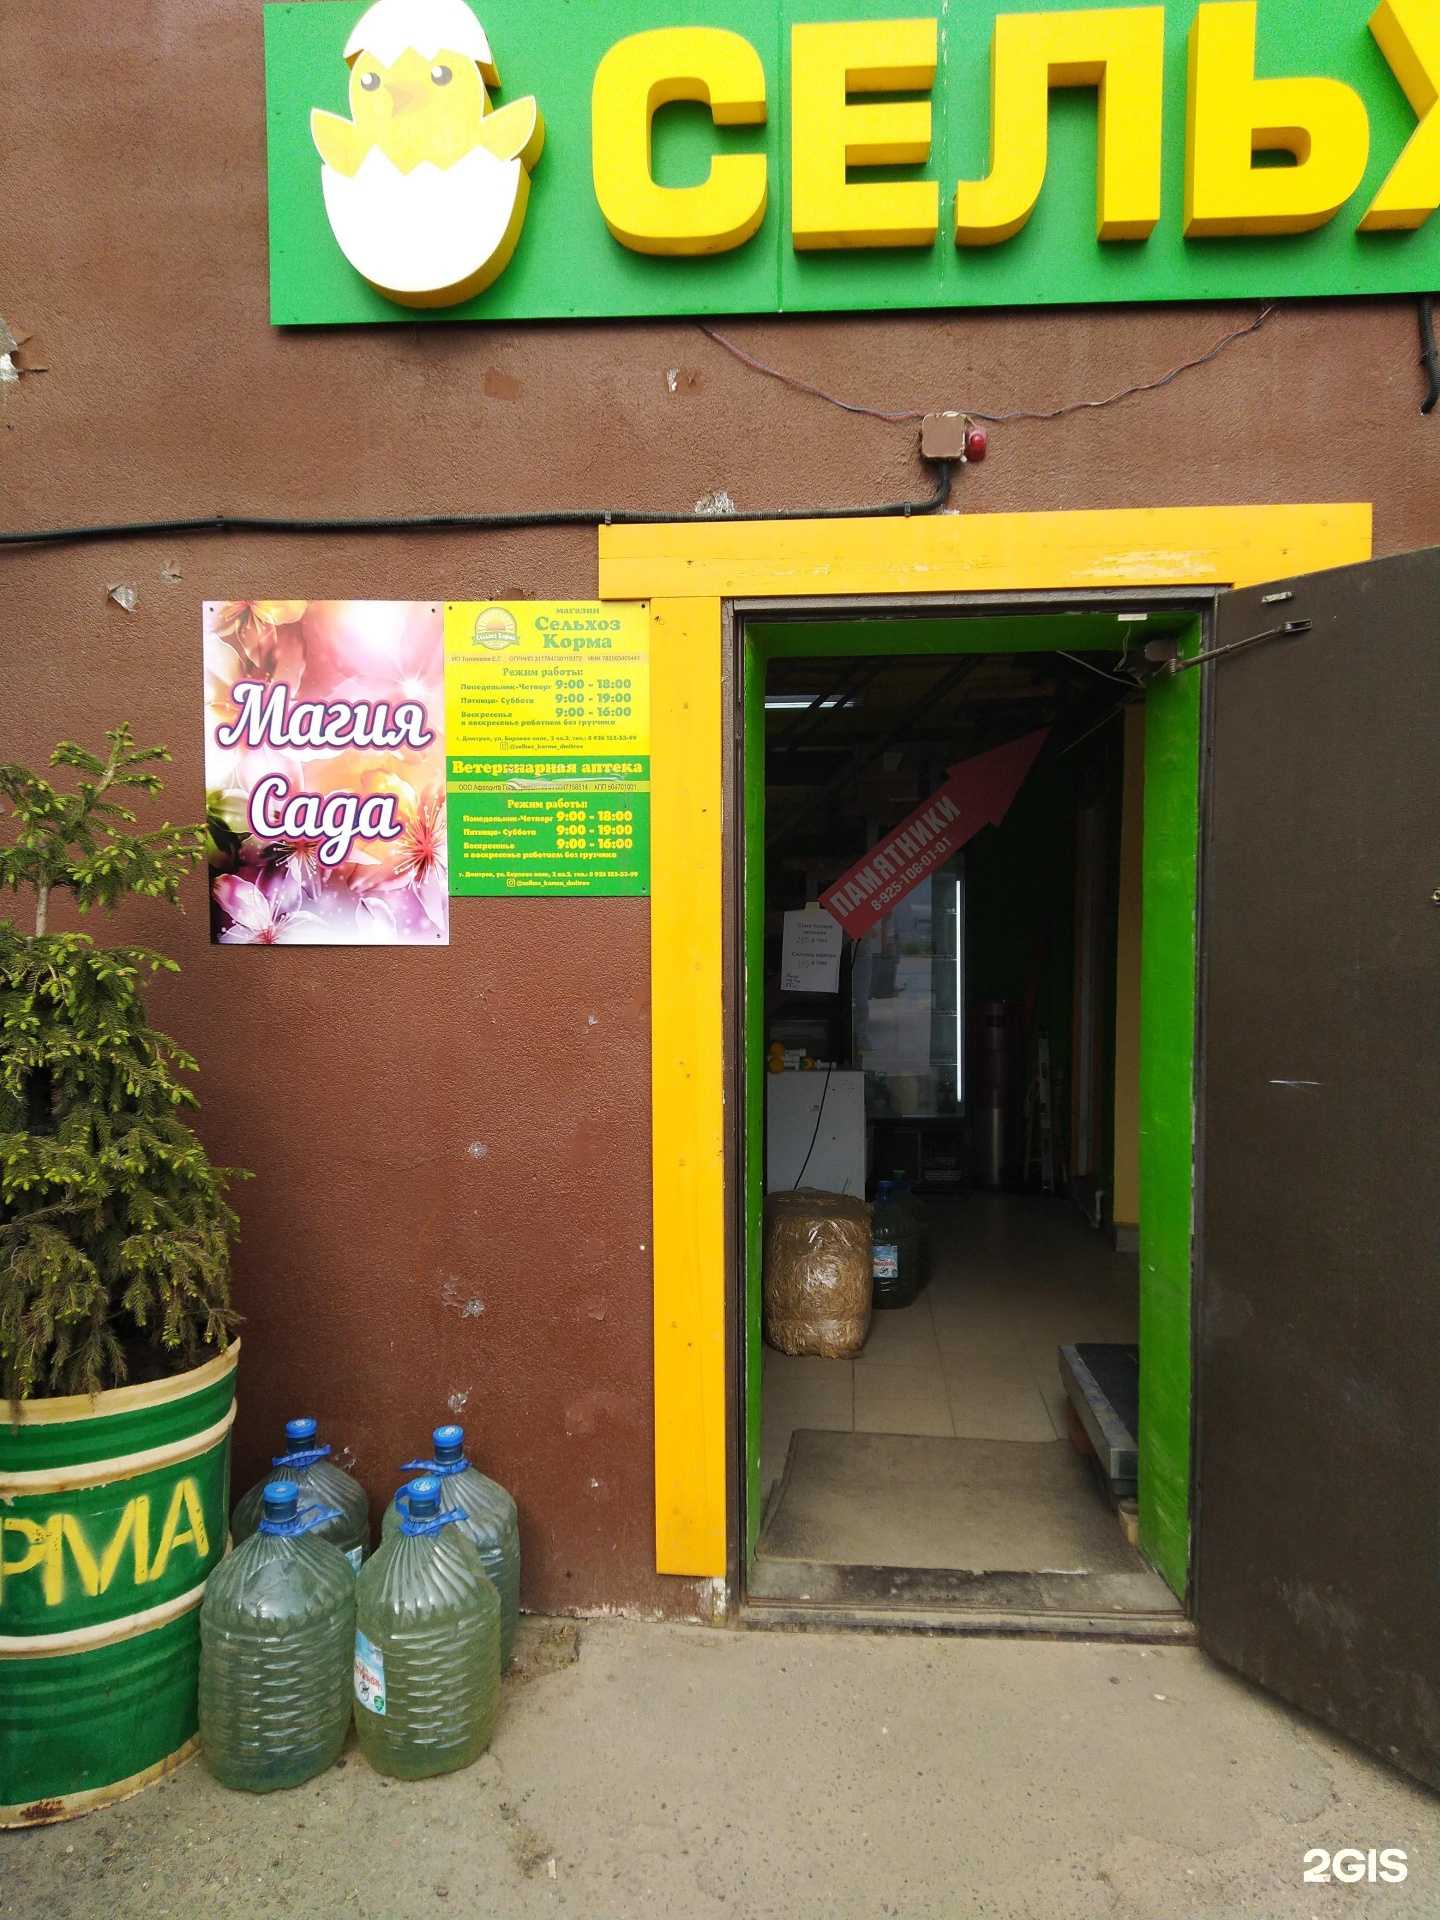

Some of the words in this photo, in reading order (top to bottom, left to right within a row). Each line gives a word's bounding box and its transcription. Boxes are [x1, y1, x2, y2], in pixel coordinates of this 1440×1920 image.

[534, 616, 621, 631] Сельхоз
[543, 633, 612, 651] Корма
[503, 667, 539, 676] Режим
[541, 666, 583, 679] работы:
[555, 679, 584, 689] 9:00
[597, 679, 632, 689] 18:00
[555, 693, 584, 703] 9:00
[597, 693, 632, 703] 19:00
[217, 681, 433, 748] Магия
[555, 707, 584, 717] 9:00
[597, 707, 632, 717] 16:00
[452, 761, 577, 776] Ветеринарная
[581, 762, 642, 773] аптека
[507, 799, 544, 809] Режим
[249, 775, 403, 867] Сада
[556, 811, 585, 822] 9:00
[598, 811, 633, 822] 18:00
[556, 825, 585, 835] 9:00
[598, 825, 633, 835] 19:00
[556, 839, 585, 849] 9:00
[598, 839, 633, 849] 16:00
[830, 795, 961, 917] ПАМЯТНИКИ
